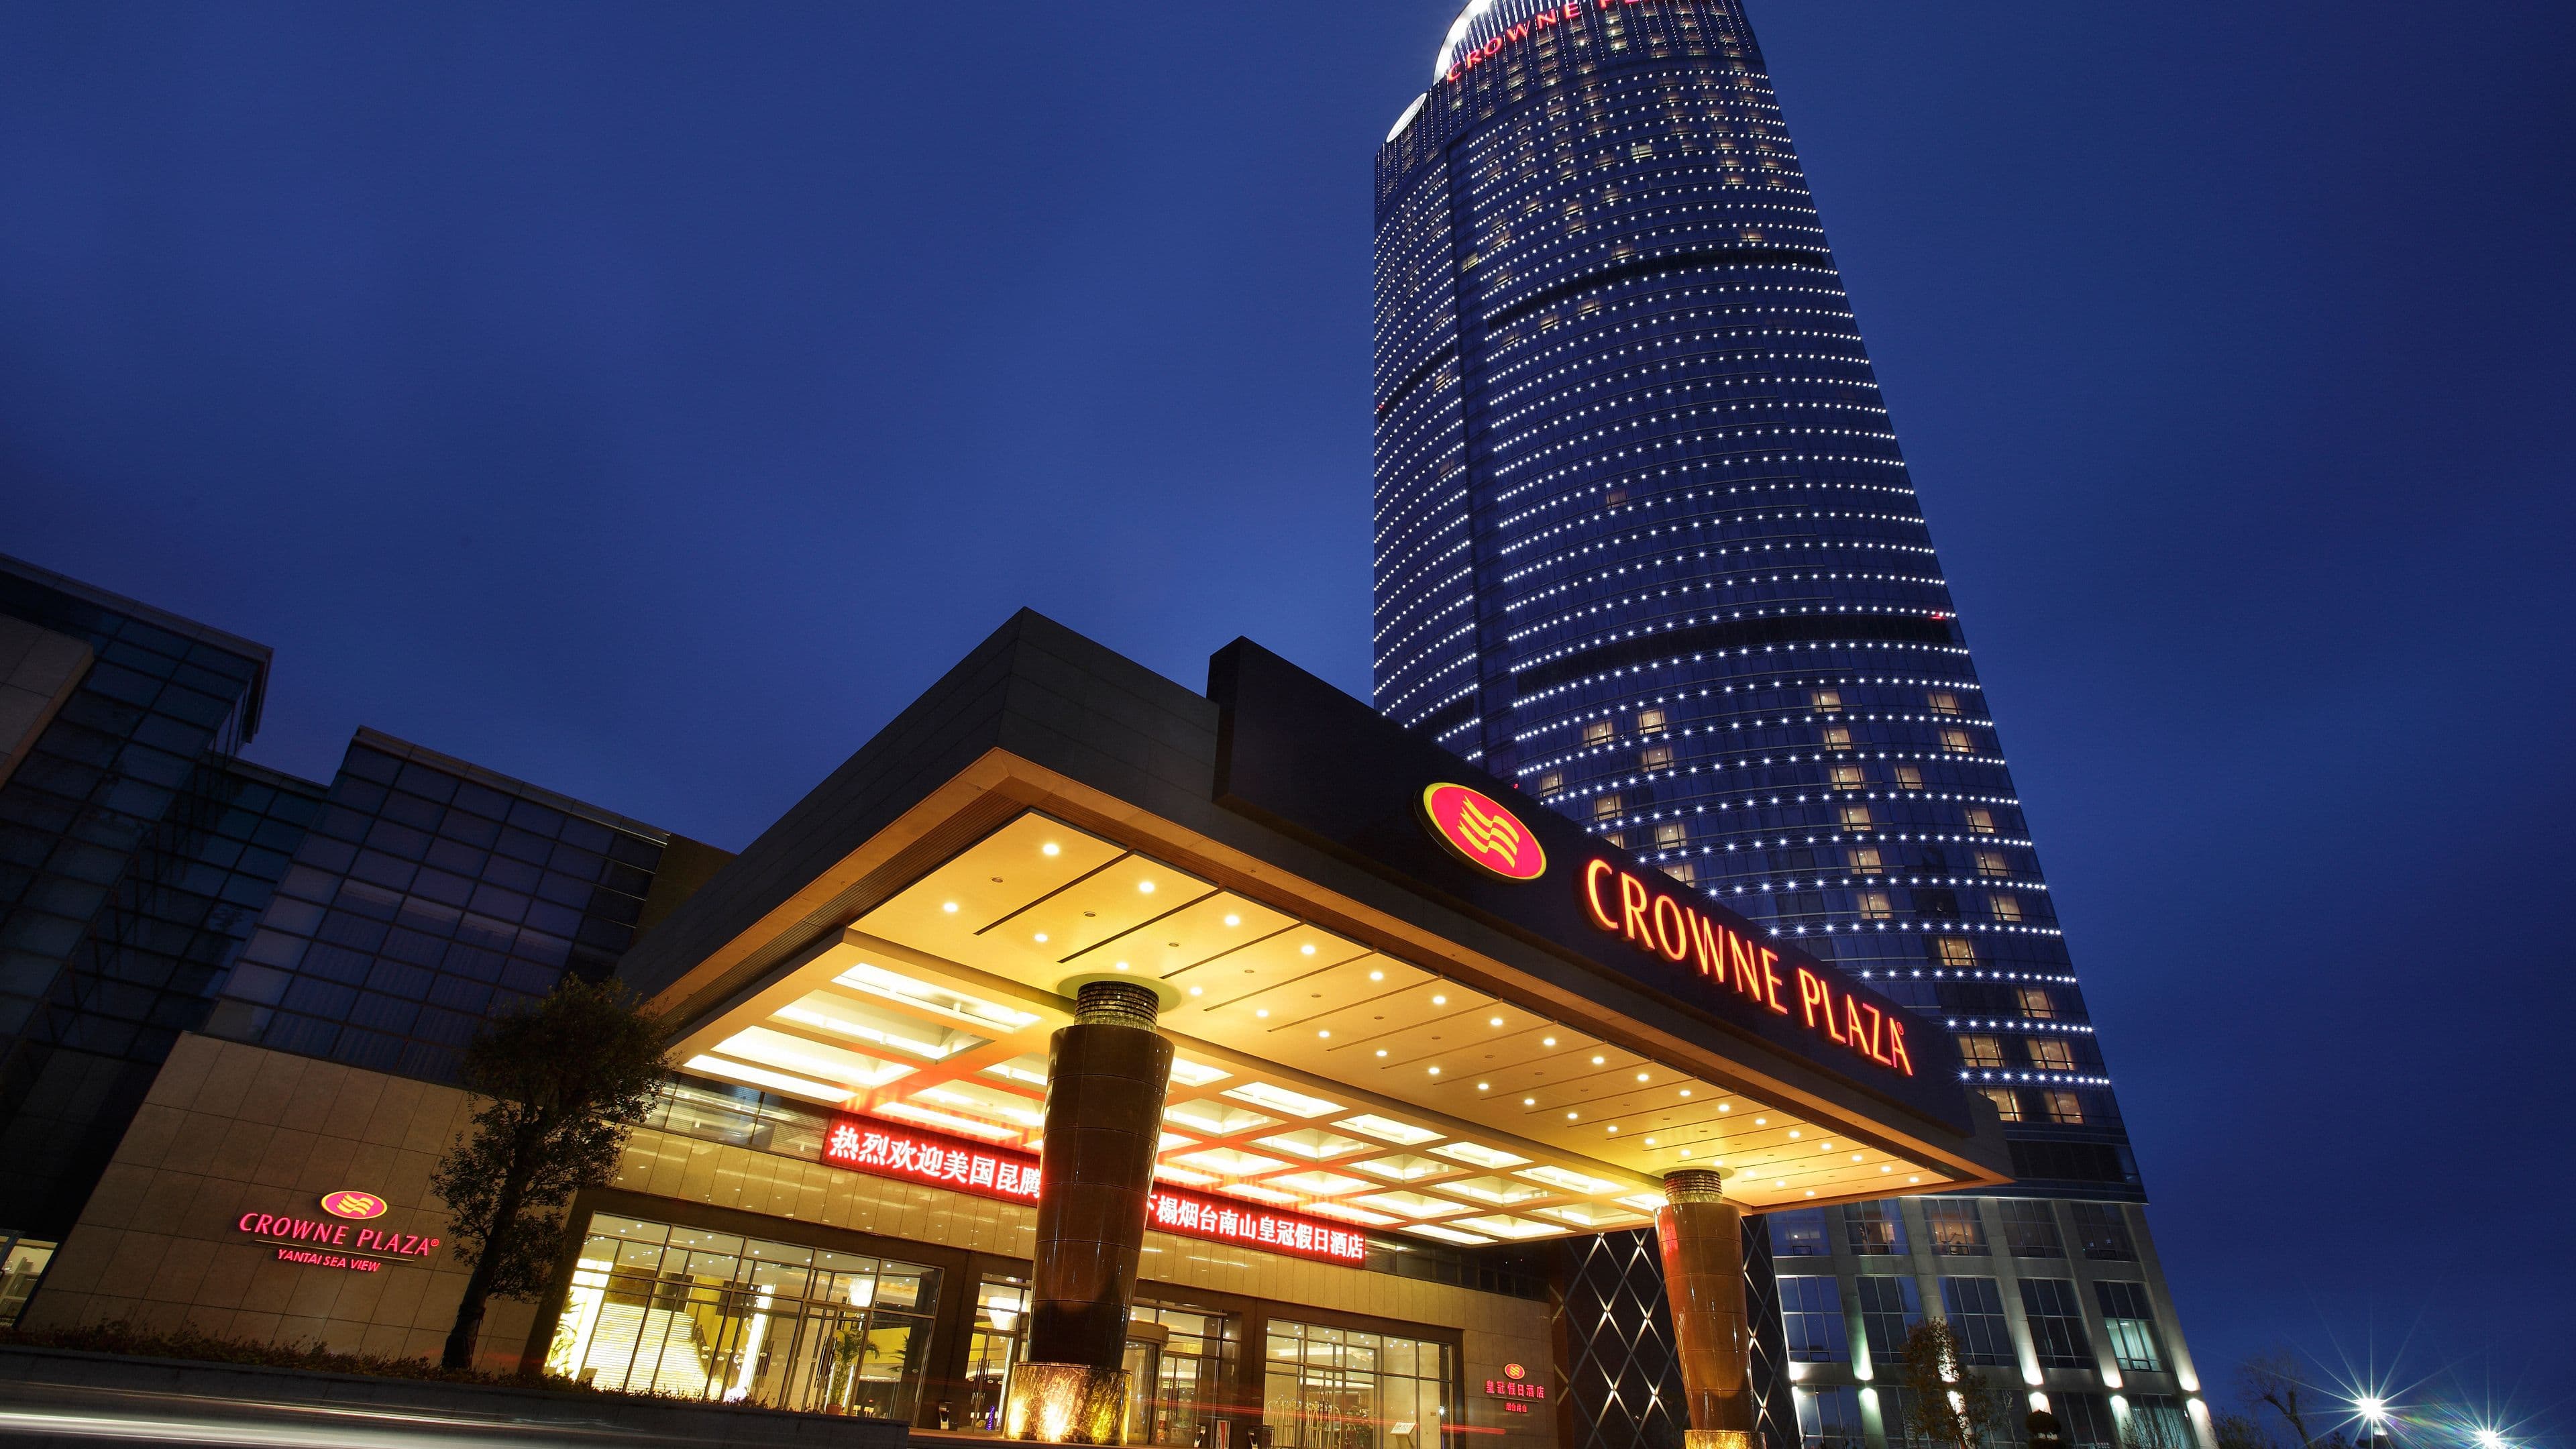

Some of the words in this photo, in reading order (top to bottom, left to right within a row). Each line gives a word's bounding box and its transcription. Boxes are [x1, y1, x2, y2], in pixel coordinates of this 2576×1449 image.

[1446, 2, 1580, 82] CROWNE
[1587, 859, 1788, 1014] CROWNE
[239, 1213, 350, 1245] CROWNE
[277, 1249, 321, 1265] YANTAI
[324, 1256, 346, 1268] SEA
[350, 1260, 381, 1273] VIEW
[1486, 1380, 1545, 1399] 皇冠假日酒店
